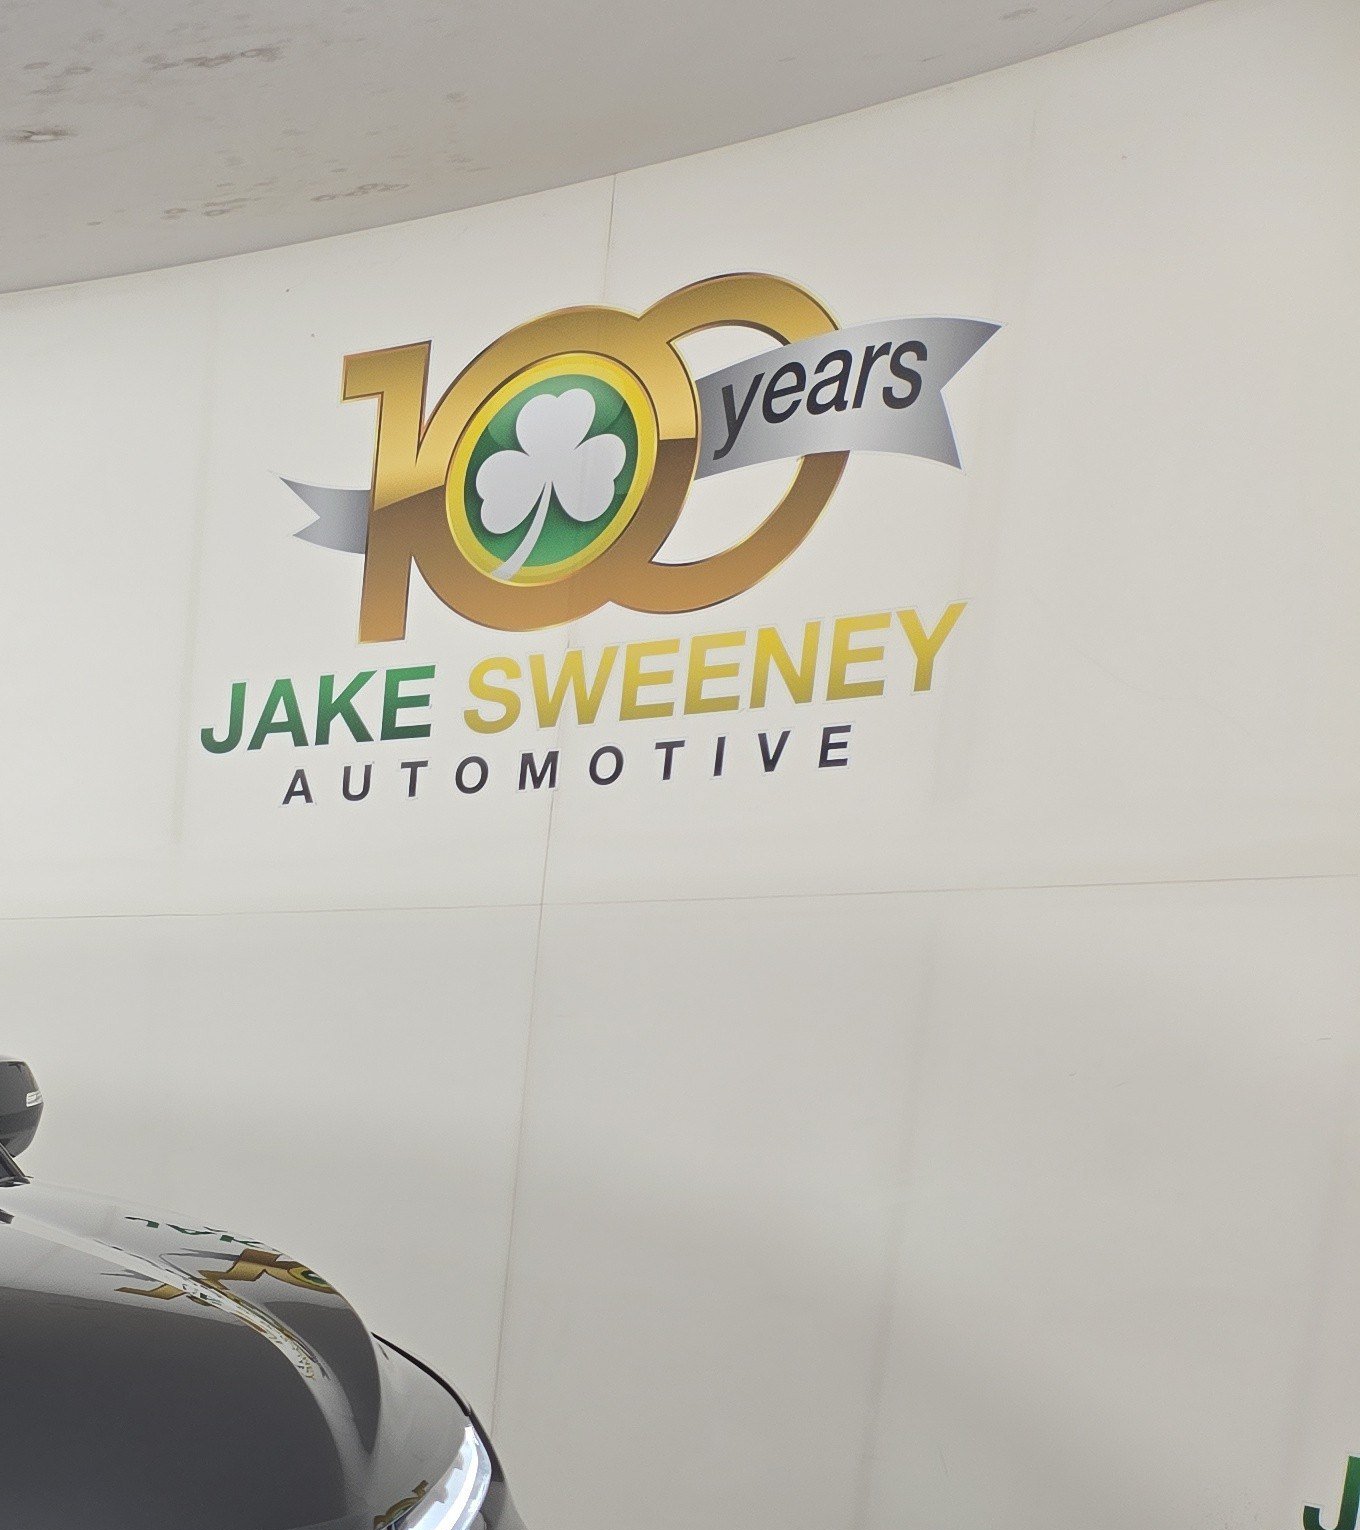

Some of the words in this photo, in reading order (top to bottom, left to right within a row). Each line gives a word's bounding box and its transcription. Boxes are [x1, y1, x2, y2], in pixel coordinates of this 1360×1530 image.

[712, 339, 928, 461] years
[200, 665, 435, 755] JAKE
[464, 603, 967, 735] SWEENEY
[282, 724, 853, 806] AUTOMOTIVE
